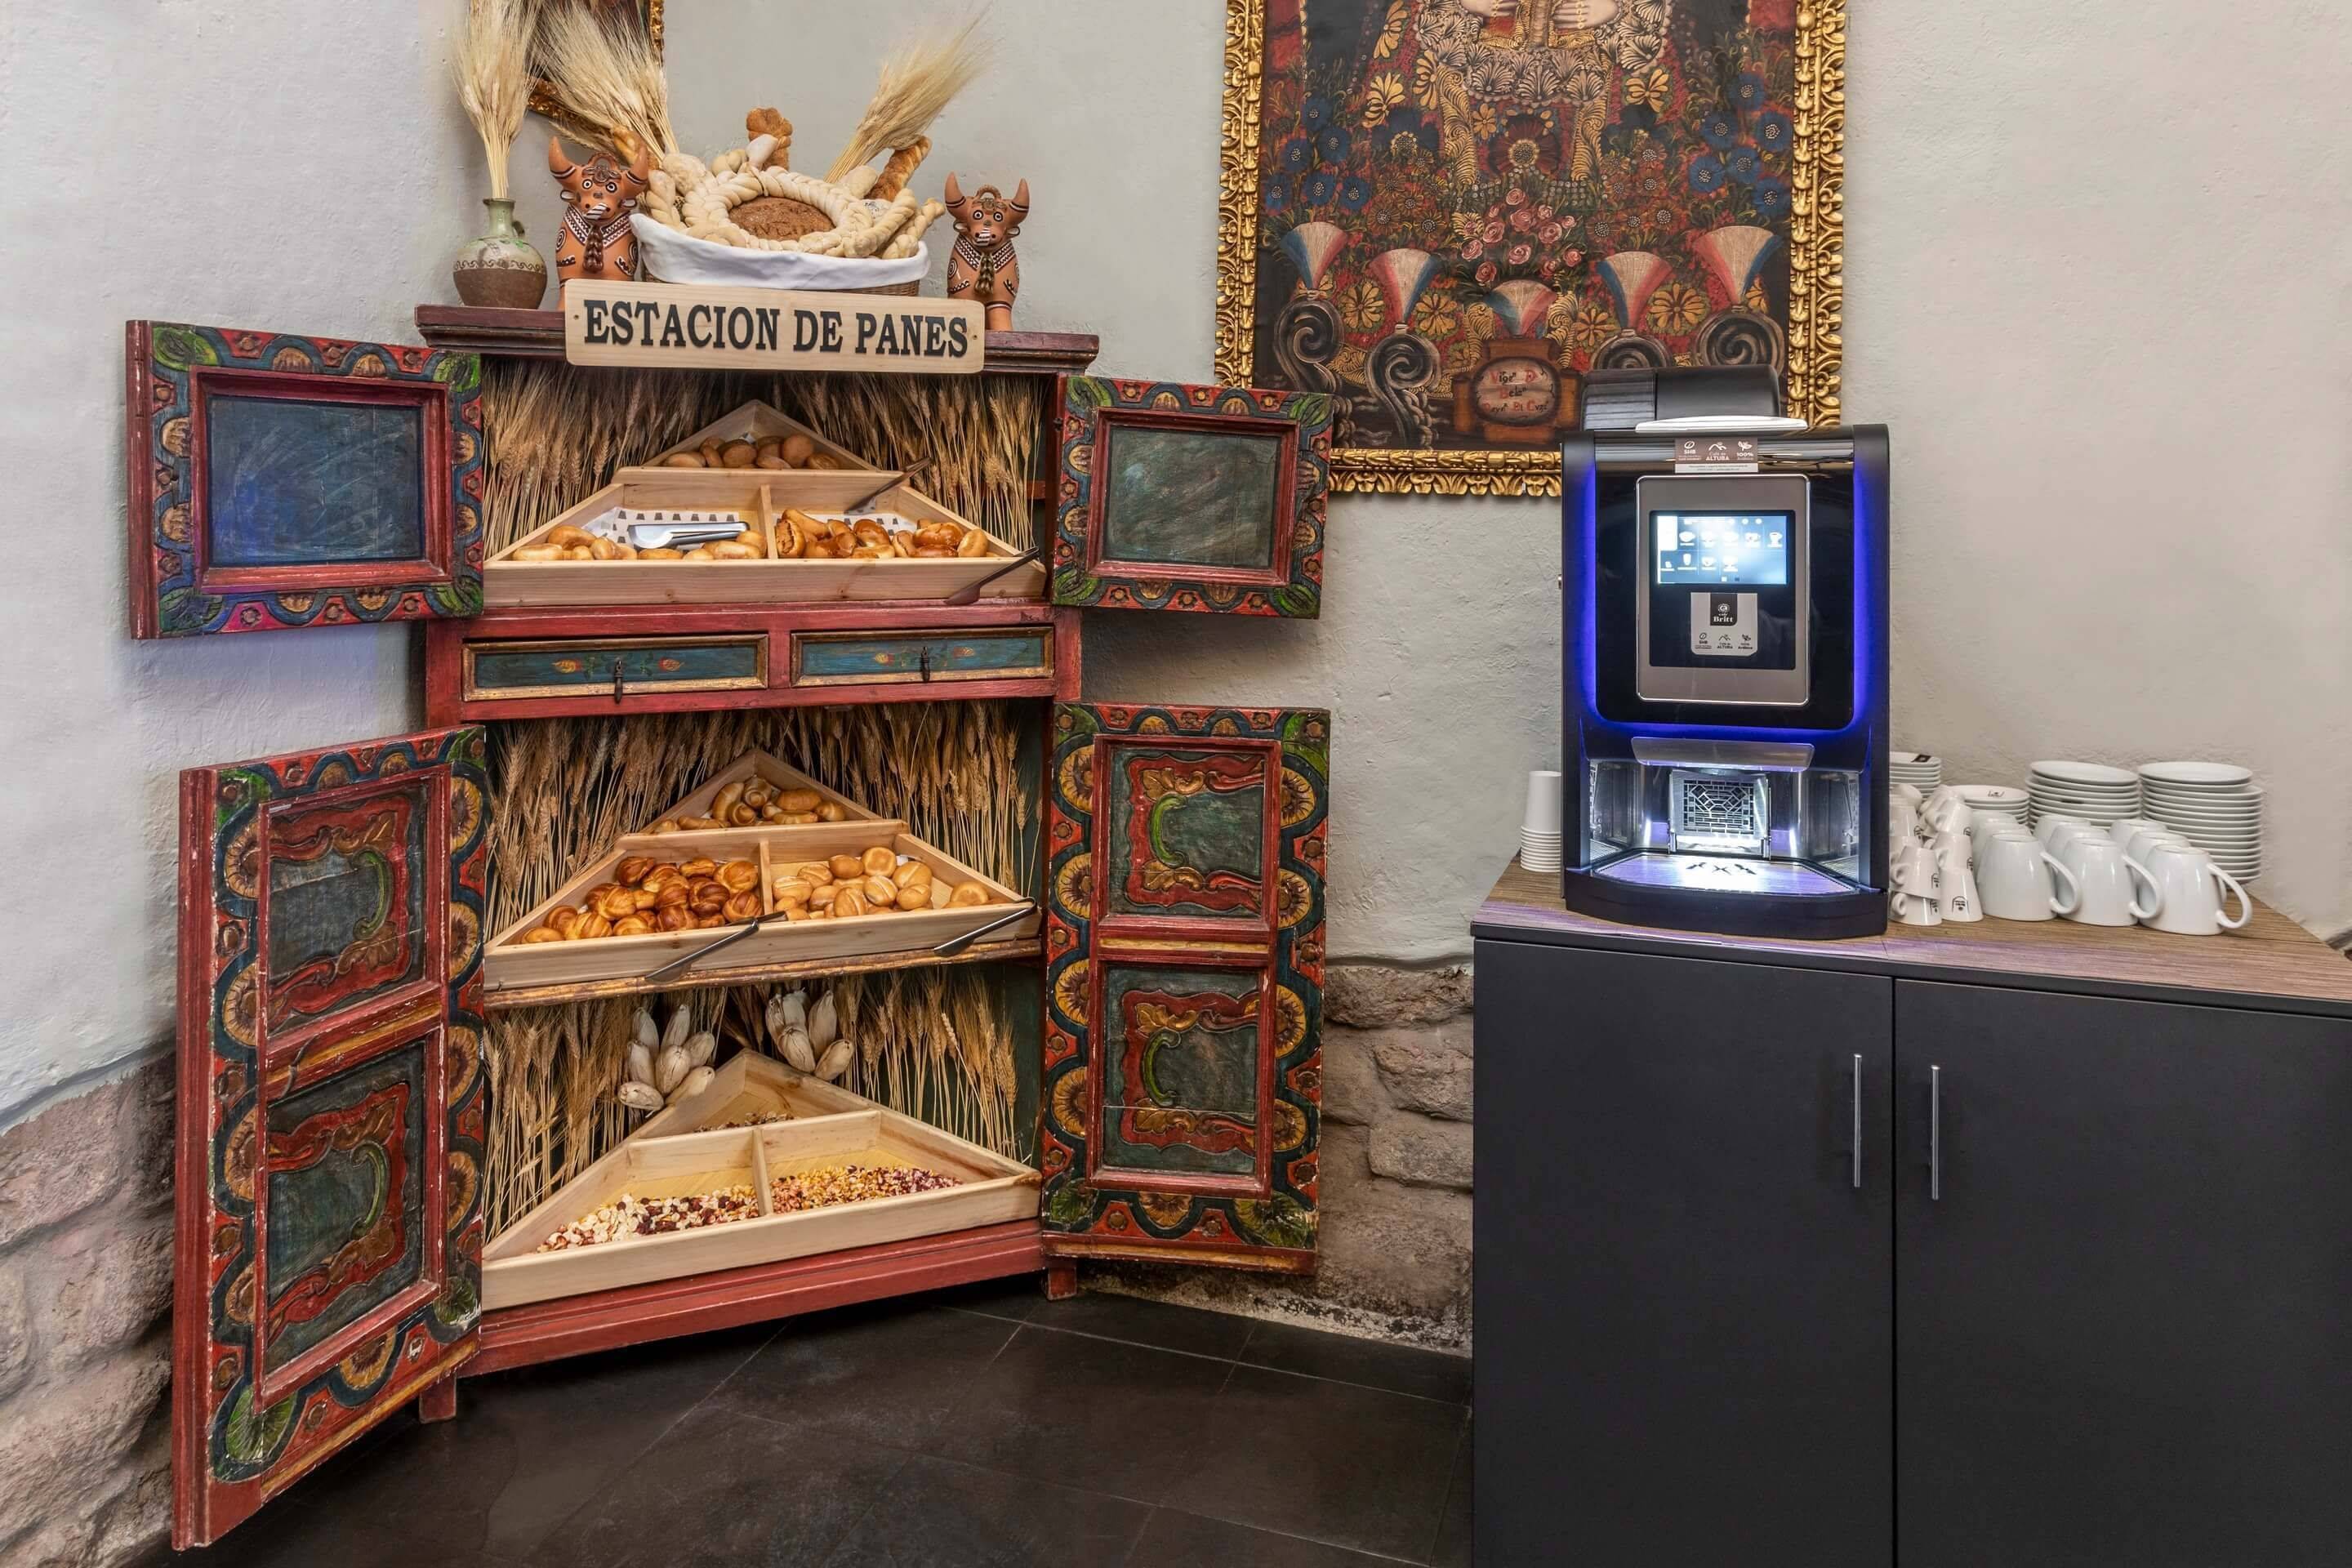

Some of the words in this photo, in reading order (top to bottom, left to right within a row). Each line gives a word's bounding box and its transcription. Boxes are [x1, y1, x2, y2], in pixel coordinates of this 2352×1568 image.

[584, 299, 780, 350] ESTACION
[793, 310, 844, 353] DE
[854, 312, 969, 358] PANES
